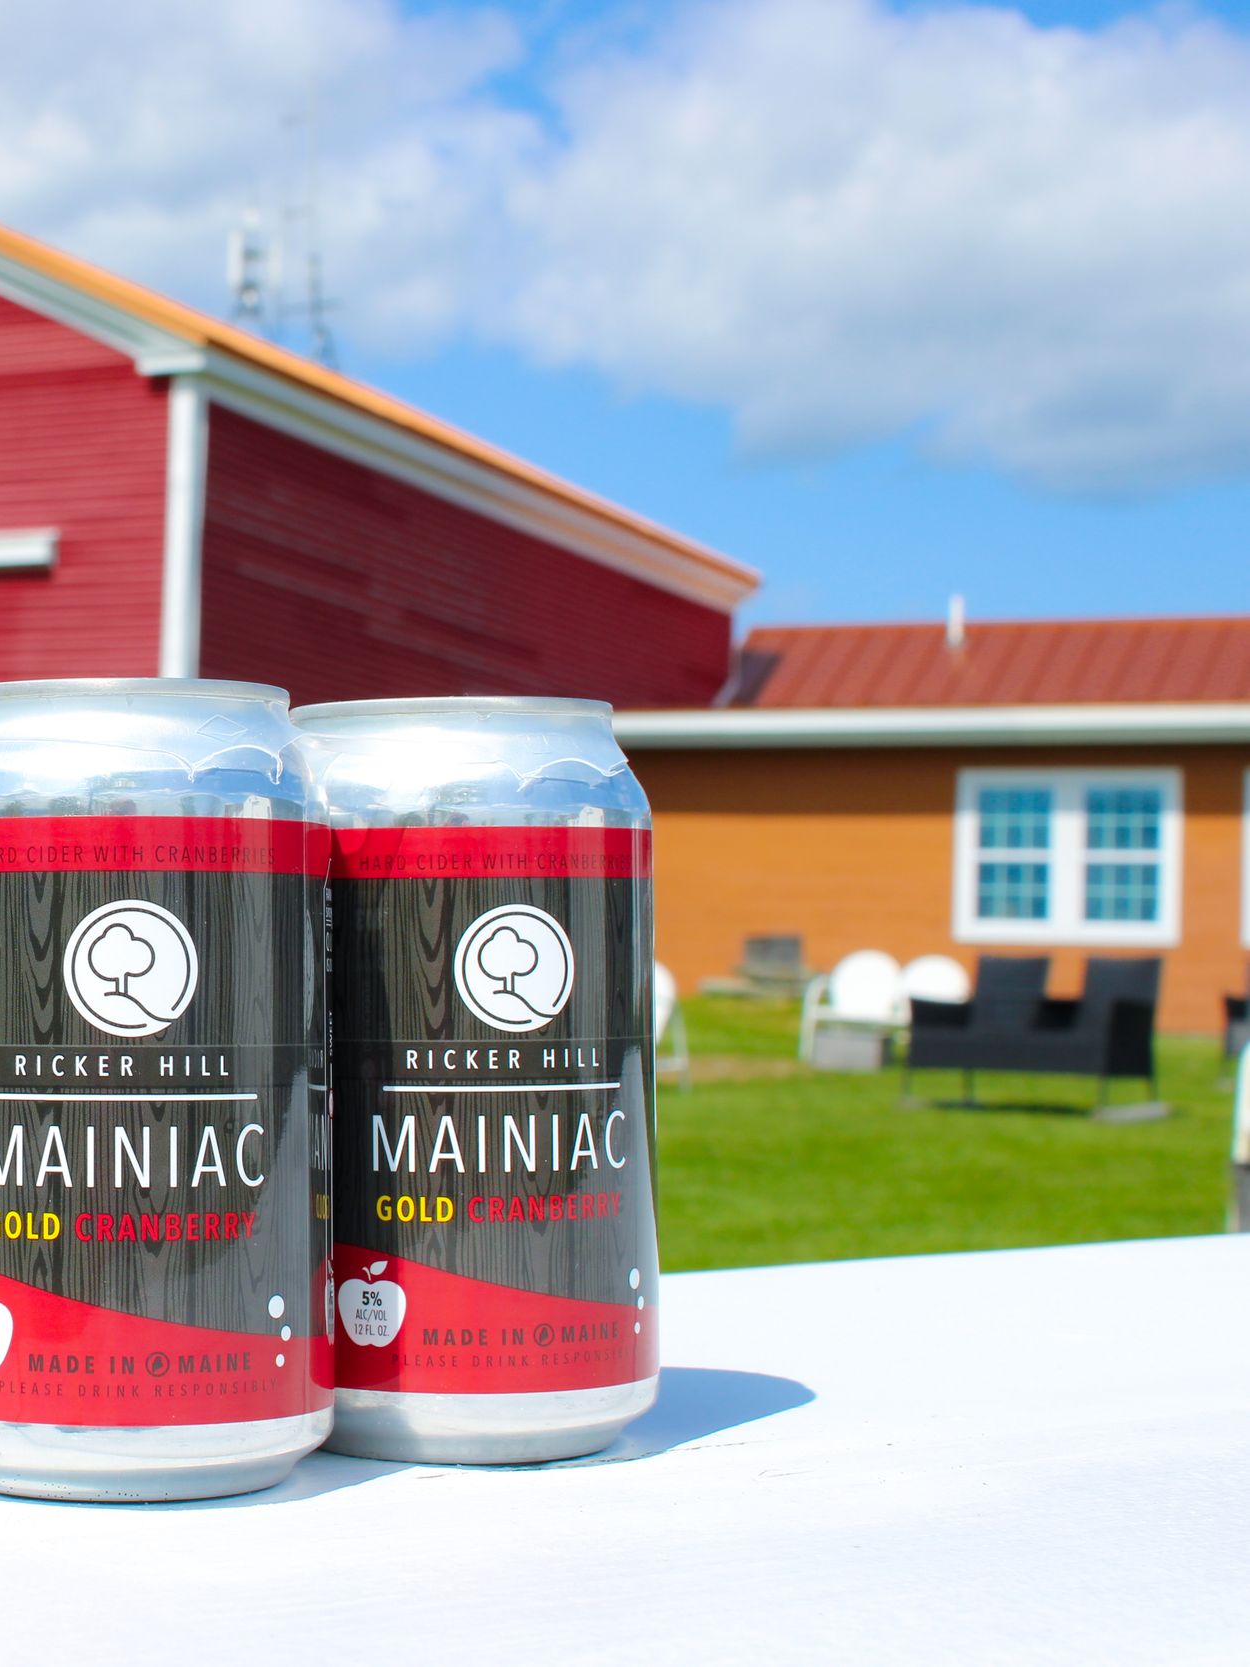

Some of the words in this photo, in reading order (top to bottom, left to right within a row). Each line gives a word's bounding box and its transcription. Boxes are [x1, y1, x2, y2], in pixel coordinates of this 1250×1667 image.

[27, 846, 83, 863] CIDER
[94, 845, 143, 862] WITH
[155, 846, 276, 864] CRANBERRIES
[360, 856, 407, 870] HARD
[416, 854, 472, 870] CIDER
[482, 854, 527, 870] WITH
[15, 1055, 134, 1077] RICKER
[160, 1055, 229, 1077] HILL
[406, 1049, 521, 1070] RICKER
[543, 1047, 600, 1068] HILL
[372, 1110, 626, 1173] MAINIAC
[376, 1195, 454, 1223] GOLD
[468, 1192, 622, 1224] CRANBERRY
[74, 1211, 258, 1242] CRANBERRY
[362, 1290, 382, 1306] 5%
[355, 1310, 388, 1322] ALC/VOL
[354, 1324, 364, 1336] 12
[365, 1325, 375, 1336] FL.
[378, 1326, 390, 1336] OZ.
[423, 1328, 488, 1346] MADE
[502, 1328, 524, 1346] IN
[562, 1321, 619, 1343] MAINE
[28, 1354, 95, 1374] MADE
[110, 1356, 135, 1375] IN
[178, 1352, 250, 1374] MAINE
[392, 1354, 458, 1367] PLEASE
[472, 1355, 529, 1368] DRINK
[78, 1384, 139, 1398] DRINK
[155, 1378, 278, 1397] RESPONSIBLY
